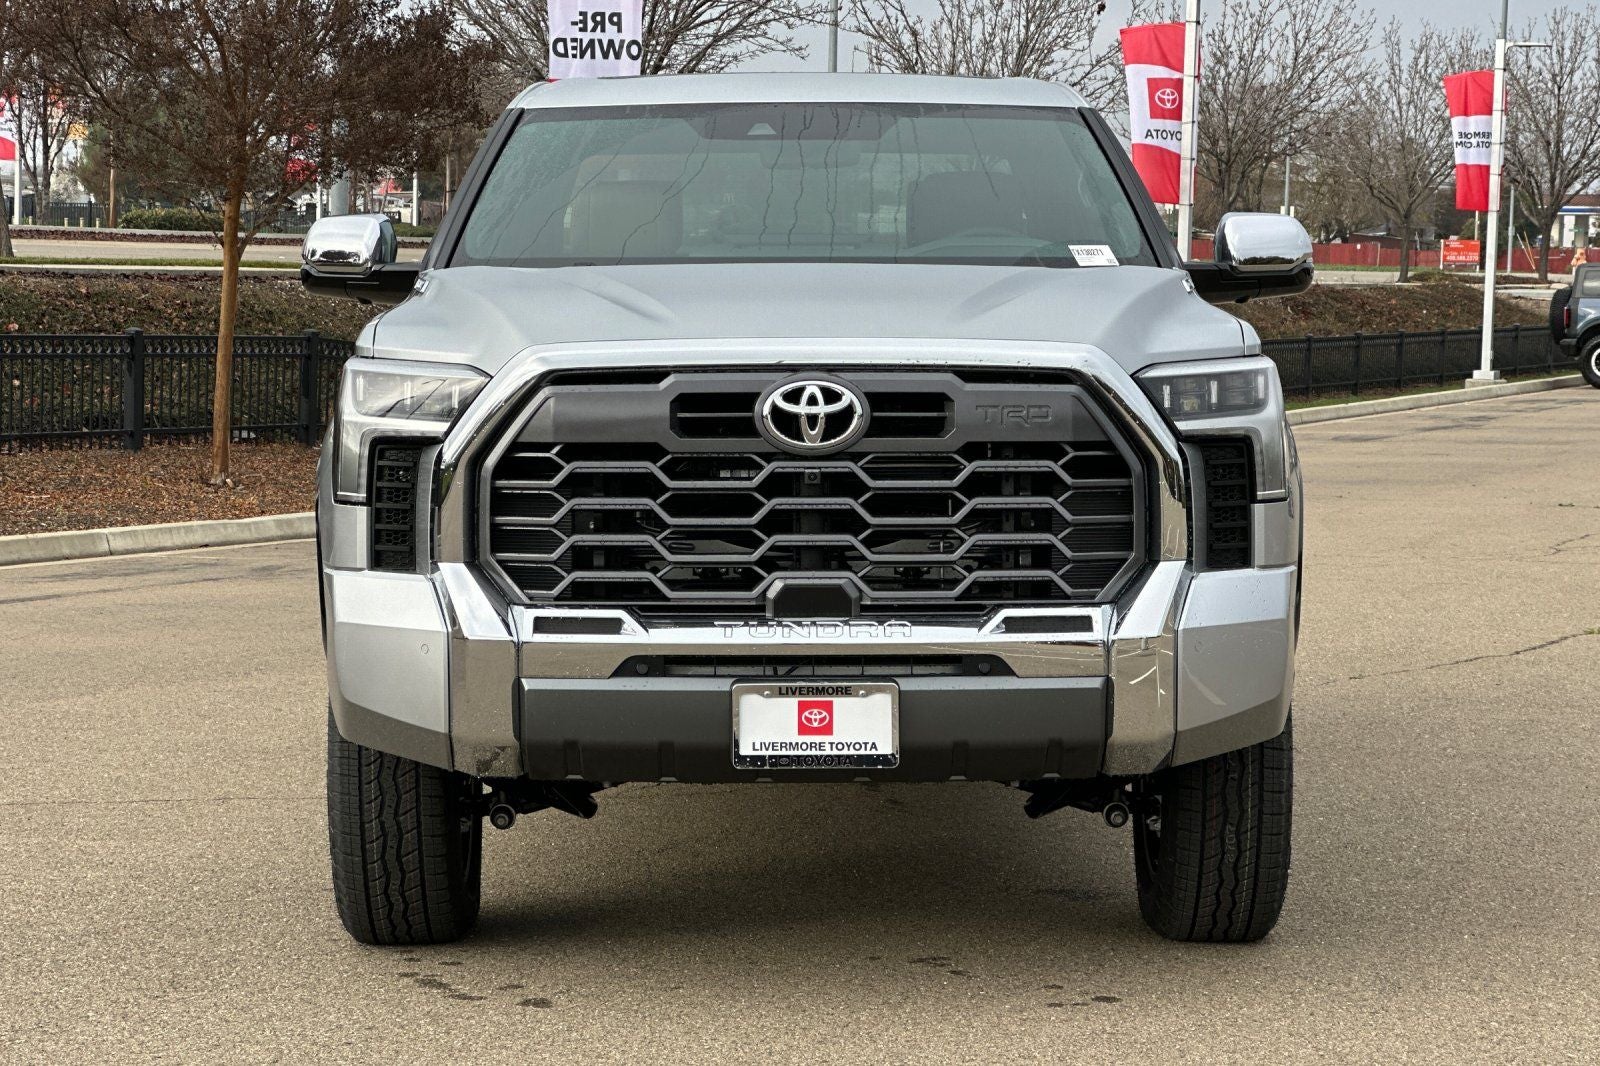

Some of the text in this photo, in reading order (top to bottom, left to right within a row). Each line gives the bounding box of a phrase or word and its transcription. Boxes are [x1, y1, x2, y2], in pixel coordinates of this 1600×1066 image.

[976, 405, 1052, 426] TRD
[714, 621, 912, 638] TUNDRA
[778, 686, 853, 696] LIVERMORE
[752, 741, 879, 752] LIVERMORE TOYOTA
[794, 754, 853, 767] TOYOTA
